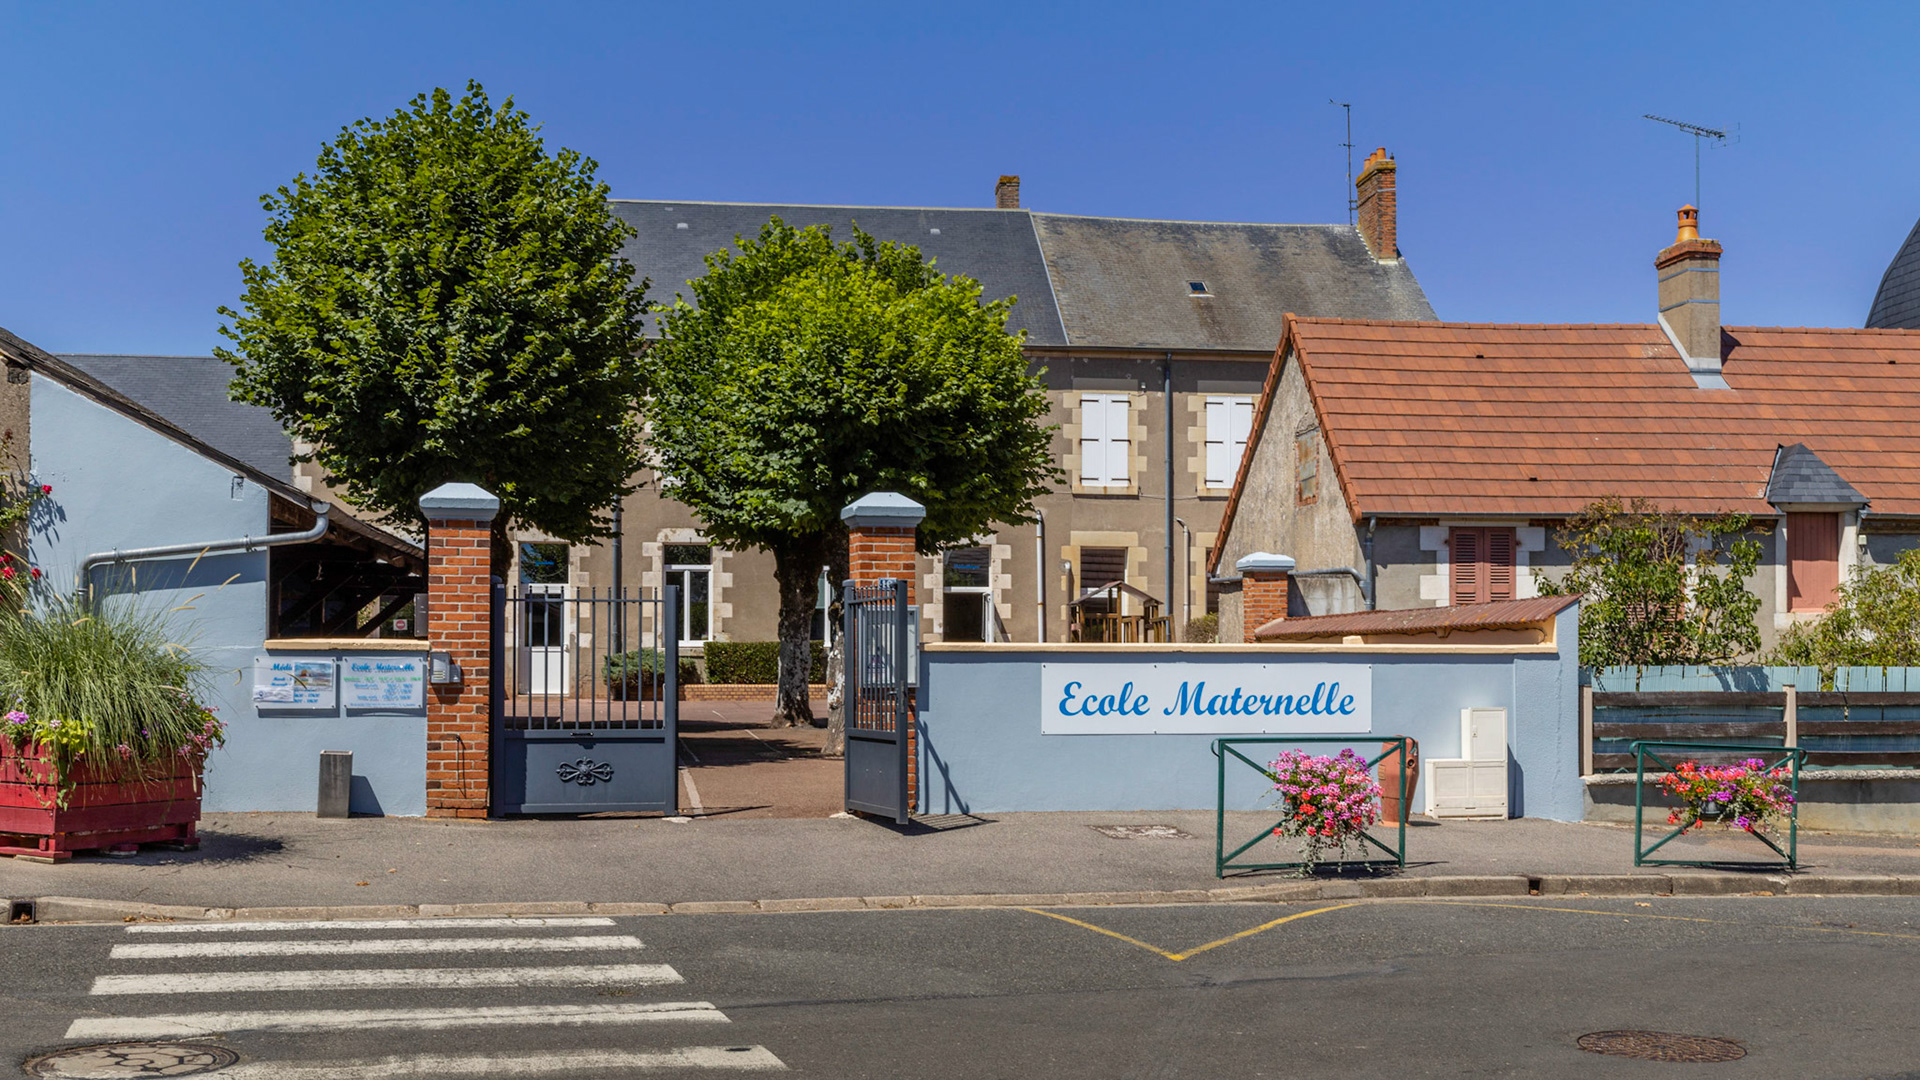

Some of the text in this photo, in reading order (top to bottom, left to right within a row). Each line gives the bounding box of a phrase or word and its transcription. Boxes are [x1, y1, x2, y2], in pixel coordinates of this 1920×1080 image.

[351, 662, 371, 672] Ecole
[1058, 681, 1356, 716] Ecole Maternelle
